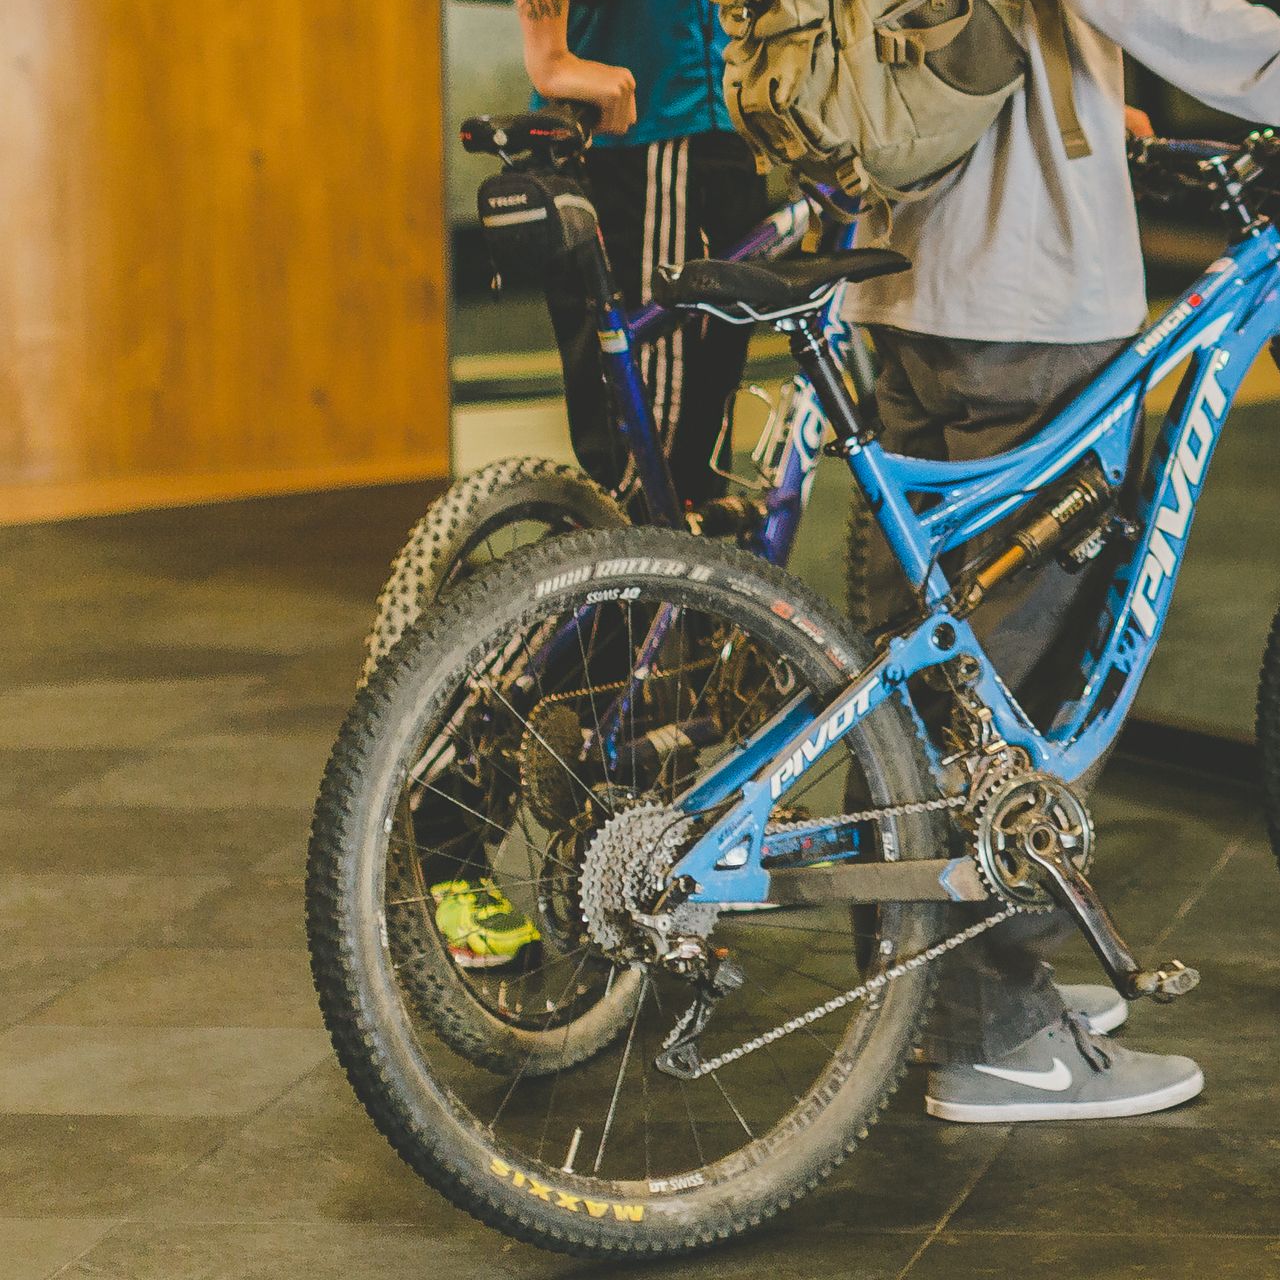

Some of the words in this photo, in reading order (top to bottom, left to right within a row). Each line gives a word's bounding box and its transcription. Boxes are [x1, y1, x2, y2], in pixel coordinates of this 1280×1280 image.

[1130, 348, 1227, 638] PIVOT
[771, 677, 880, 800] PIVOT
[490, 1158, 644, 1221] MAXXIS
[649, 1182, 668, 1194] DT
[670, 1173, 704, 1191] SWISS
